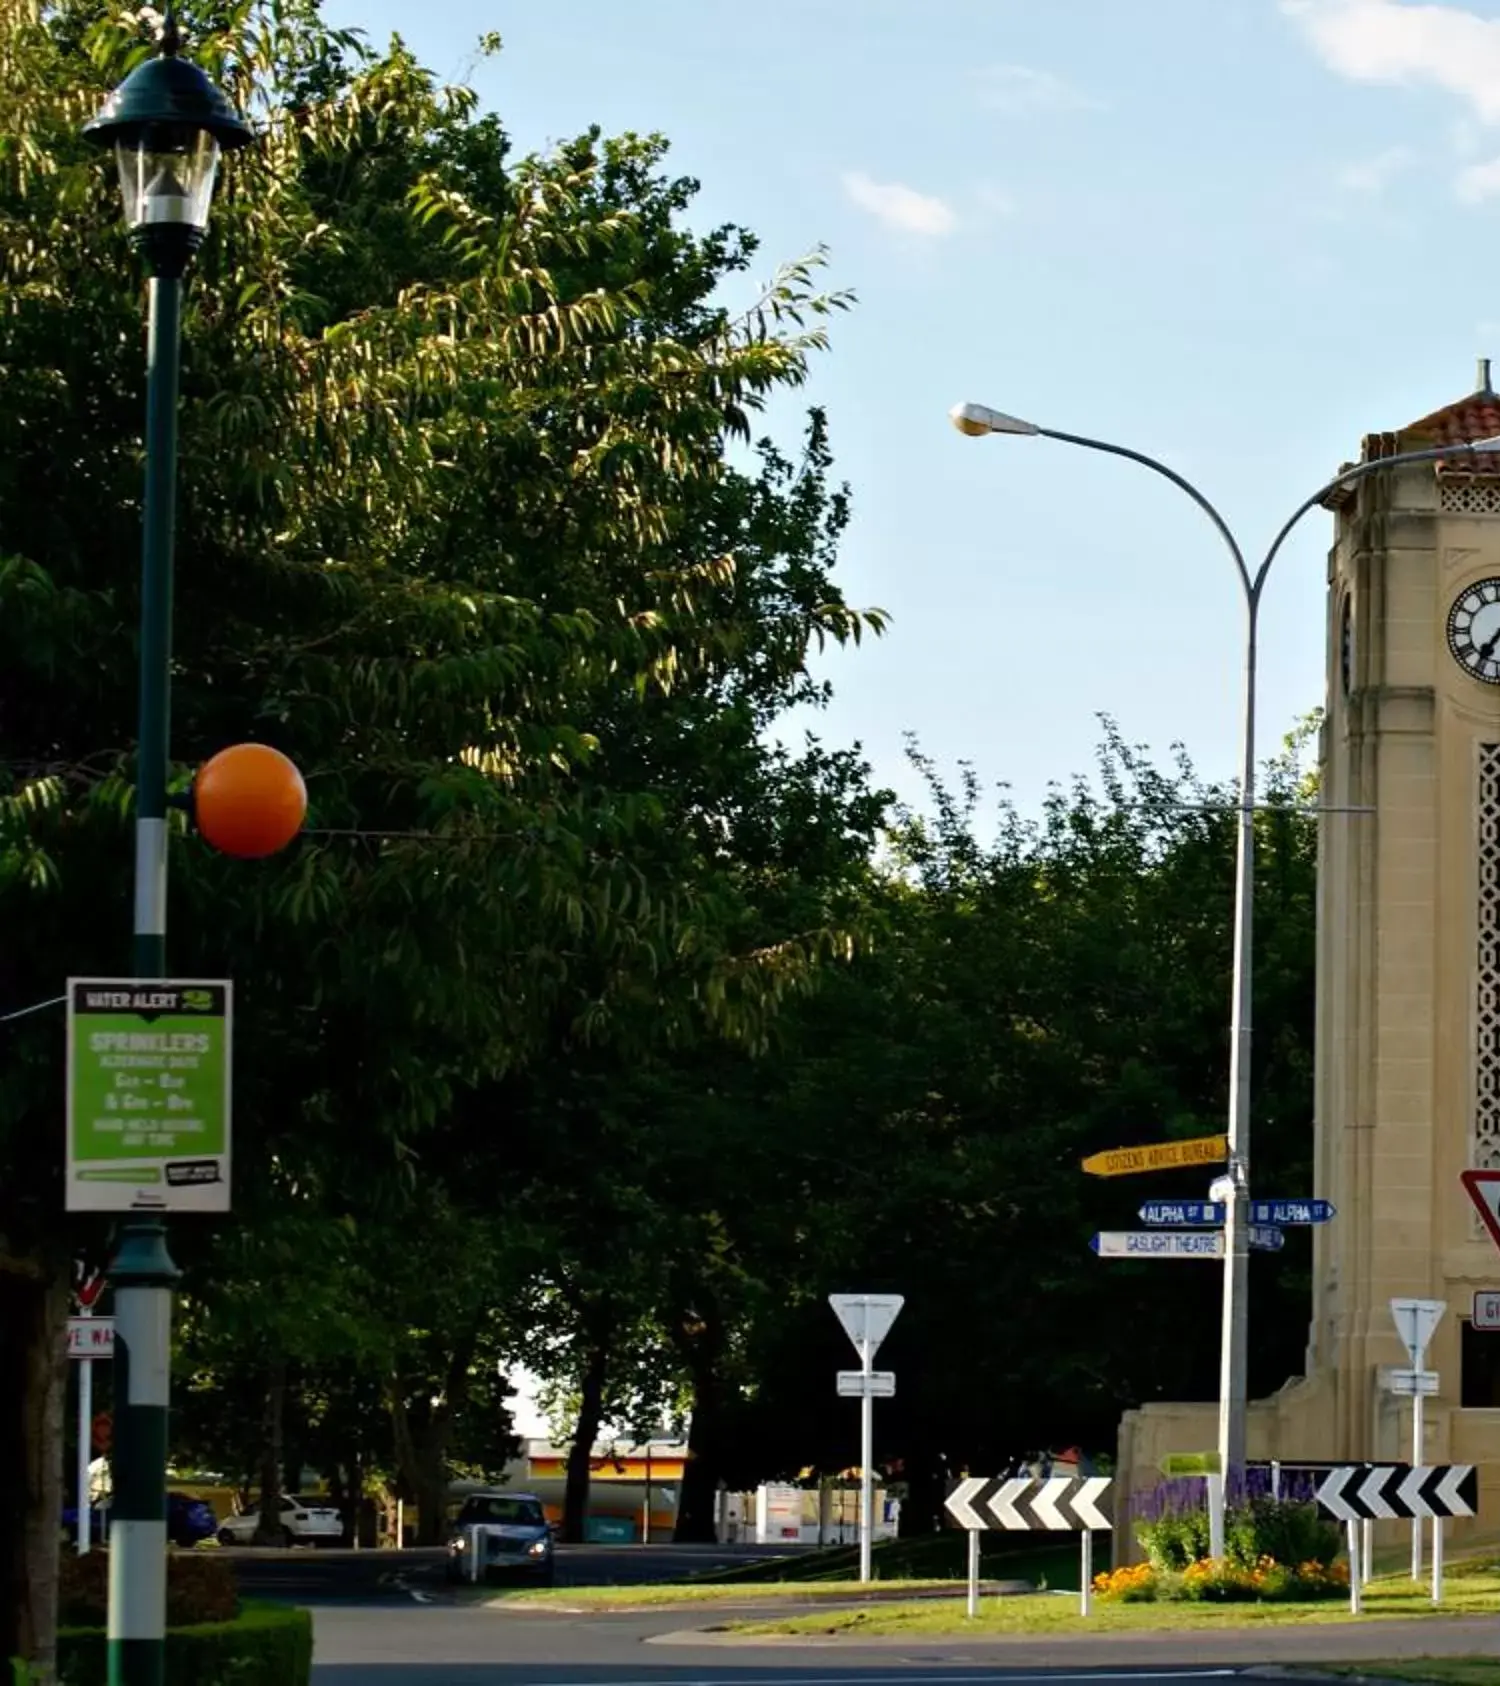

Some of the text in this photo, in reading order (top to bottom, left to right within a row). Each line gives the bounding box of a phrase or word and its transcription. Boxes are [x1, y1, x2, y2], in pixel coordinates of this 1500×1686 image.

[86, 992, 178, 1008] WATER ALERT
[1147, 1206, 1199, 1222] ALPHA ST
[1274, 1204, 1312, 1221] ALPHA
[1127, 1235, 1217, 1252] GASLIGHT THEATRE
[92, 1327, 115, 1346] WA
